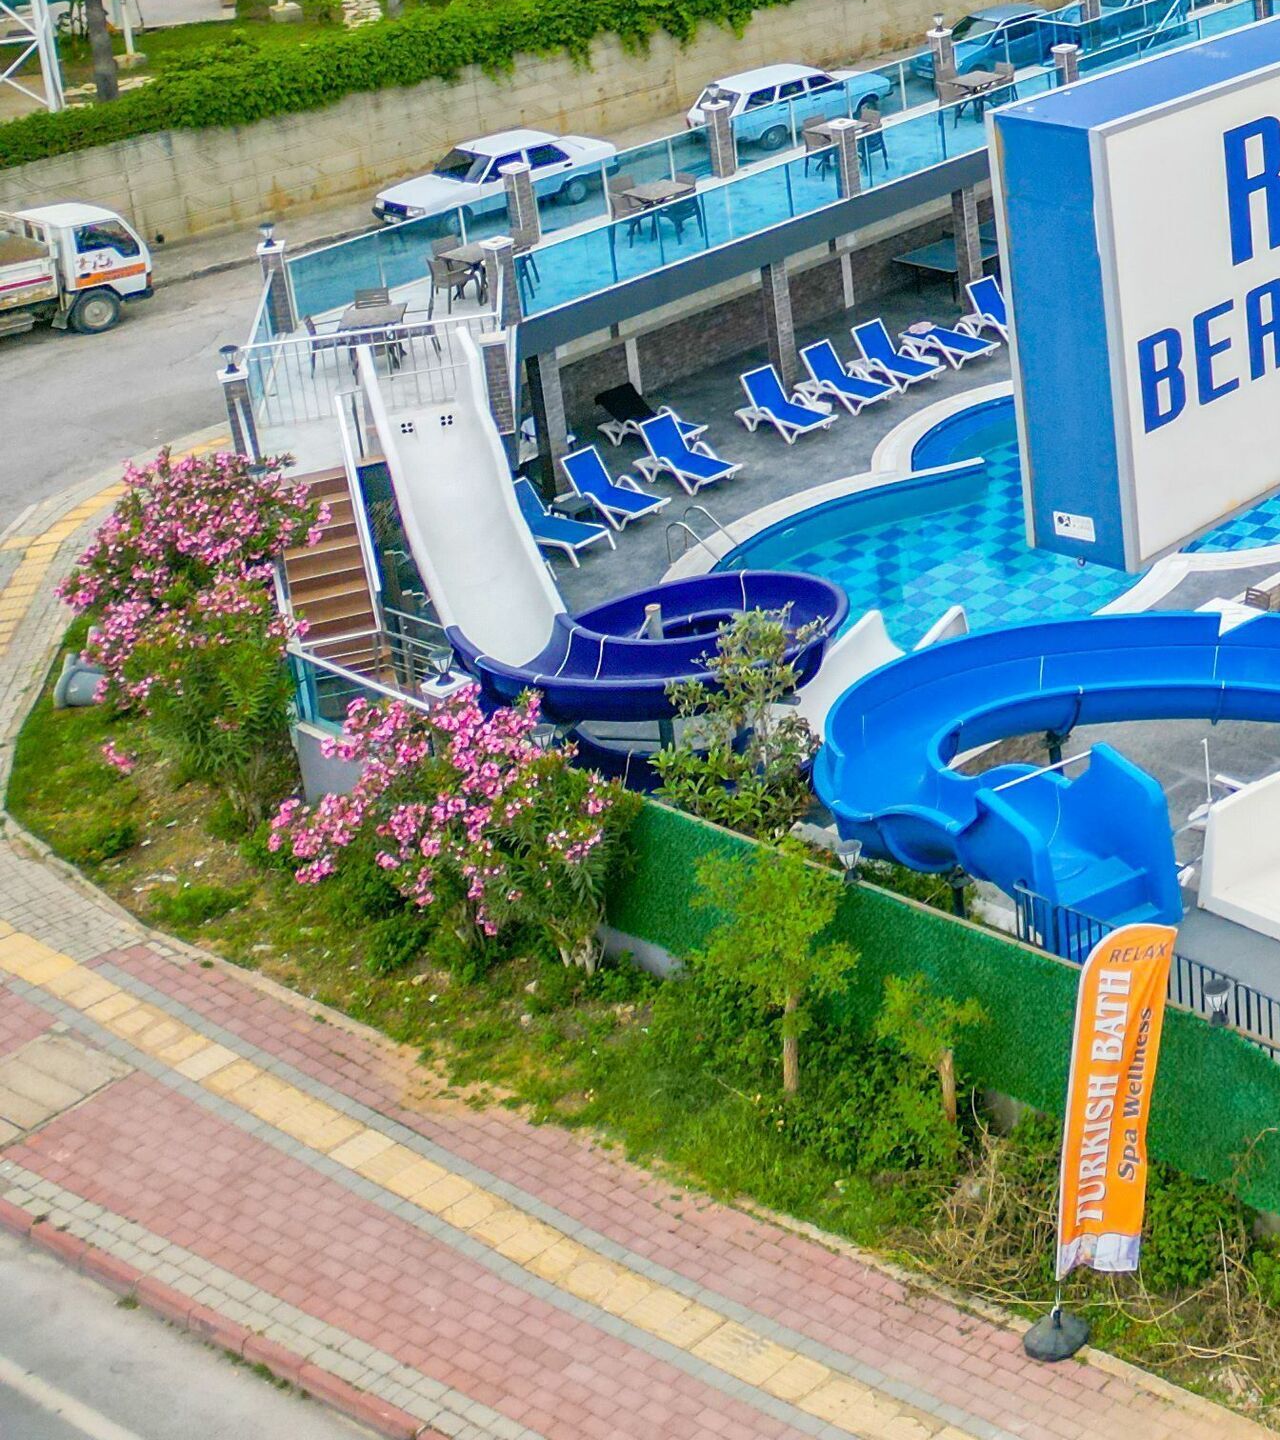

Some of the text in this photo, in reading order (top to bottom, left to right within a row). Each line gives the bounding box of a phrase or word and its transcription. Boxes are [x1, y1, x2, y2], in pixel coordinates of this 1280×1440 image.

[1109, 944, 1168, 963] RELAX
[1076, 970, 1132, 1225] TURKISH BATH
[1118, 1007, 1152, 1182] Spa Wellness
